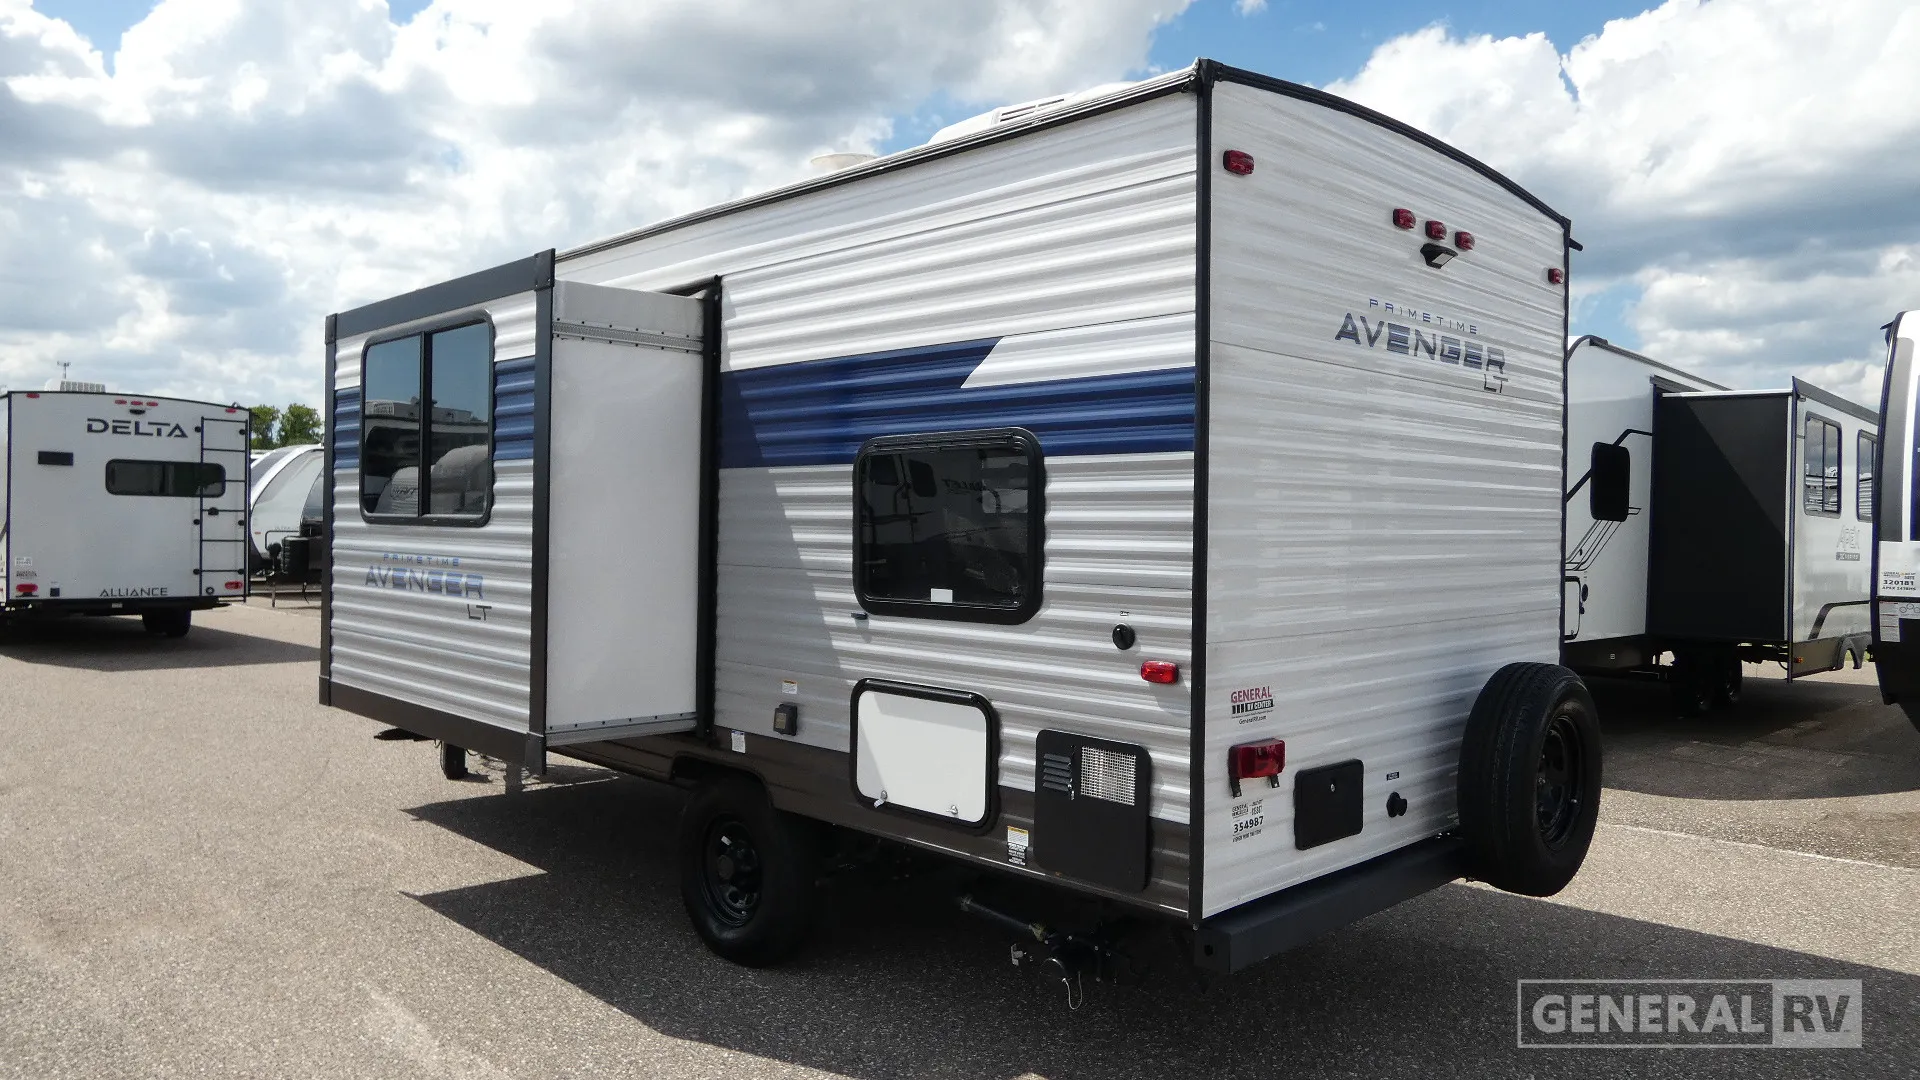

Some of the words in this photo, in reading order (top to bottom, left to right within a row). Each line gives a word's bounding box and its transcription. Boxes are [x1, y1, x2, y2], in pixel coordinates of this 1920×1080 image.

[1368, 298, 1478, 336] PRIMETIME
[1334, 312, 1506, 375] AVENGER
[1483, 373, 1509, 394] LT
[87, 417, 189, 438] DELTA
[383, 553, 460, 567] PRIMETIME
[99, 586, 169, 598] ALLIANCE
[365, 565, 484, 600] AVENGER
[466, 603, 493, 622] LT
[1231, 685, 1273, 704] GENERAL
[1233, 815, 1264, 834] 354987
